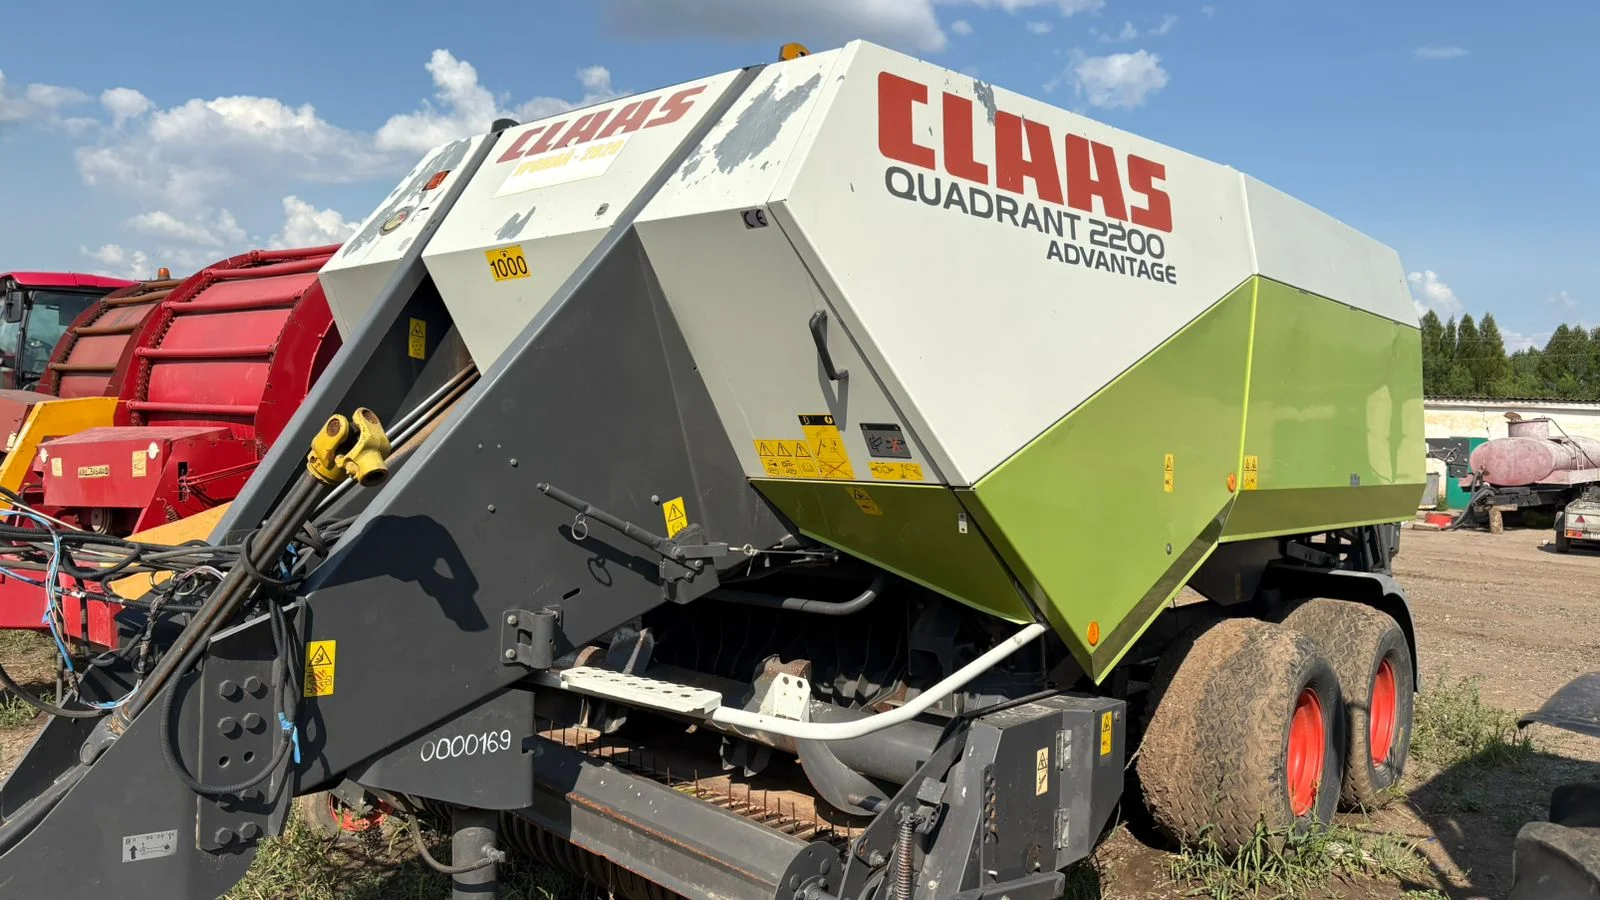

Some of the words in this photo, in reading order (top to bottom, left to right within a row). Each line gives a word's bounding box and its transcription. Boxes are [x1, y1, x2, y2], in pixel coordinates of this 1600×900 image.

[496, 85, 708, 163] CLAAS
[878, 71, 1173, 233] CLAAS
[885, 166, 1082, 241] QUADRANT
[1088, 218, 1166, 260] 2200
[490, 255, 528, 279] 1000
[1046, 240, 1178, 285] ADVANTAGE
[420, 729, 512, 762] 0000169
